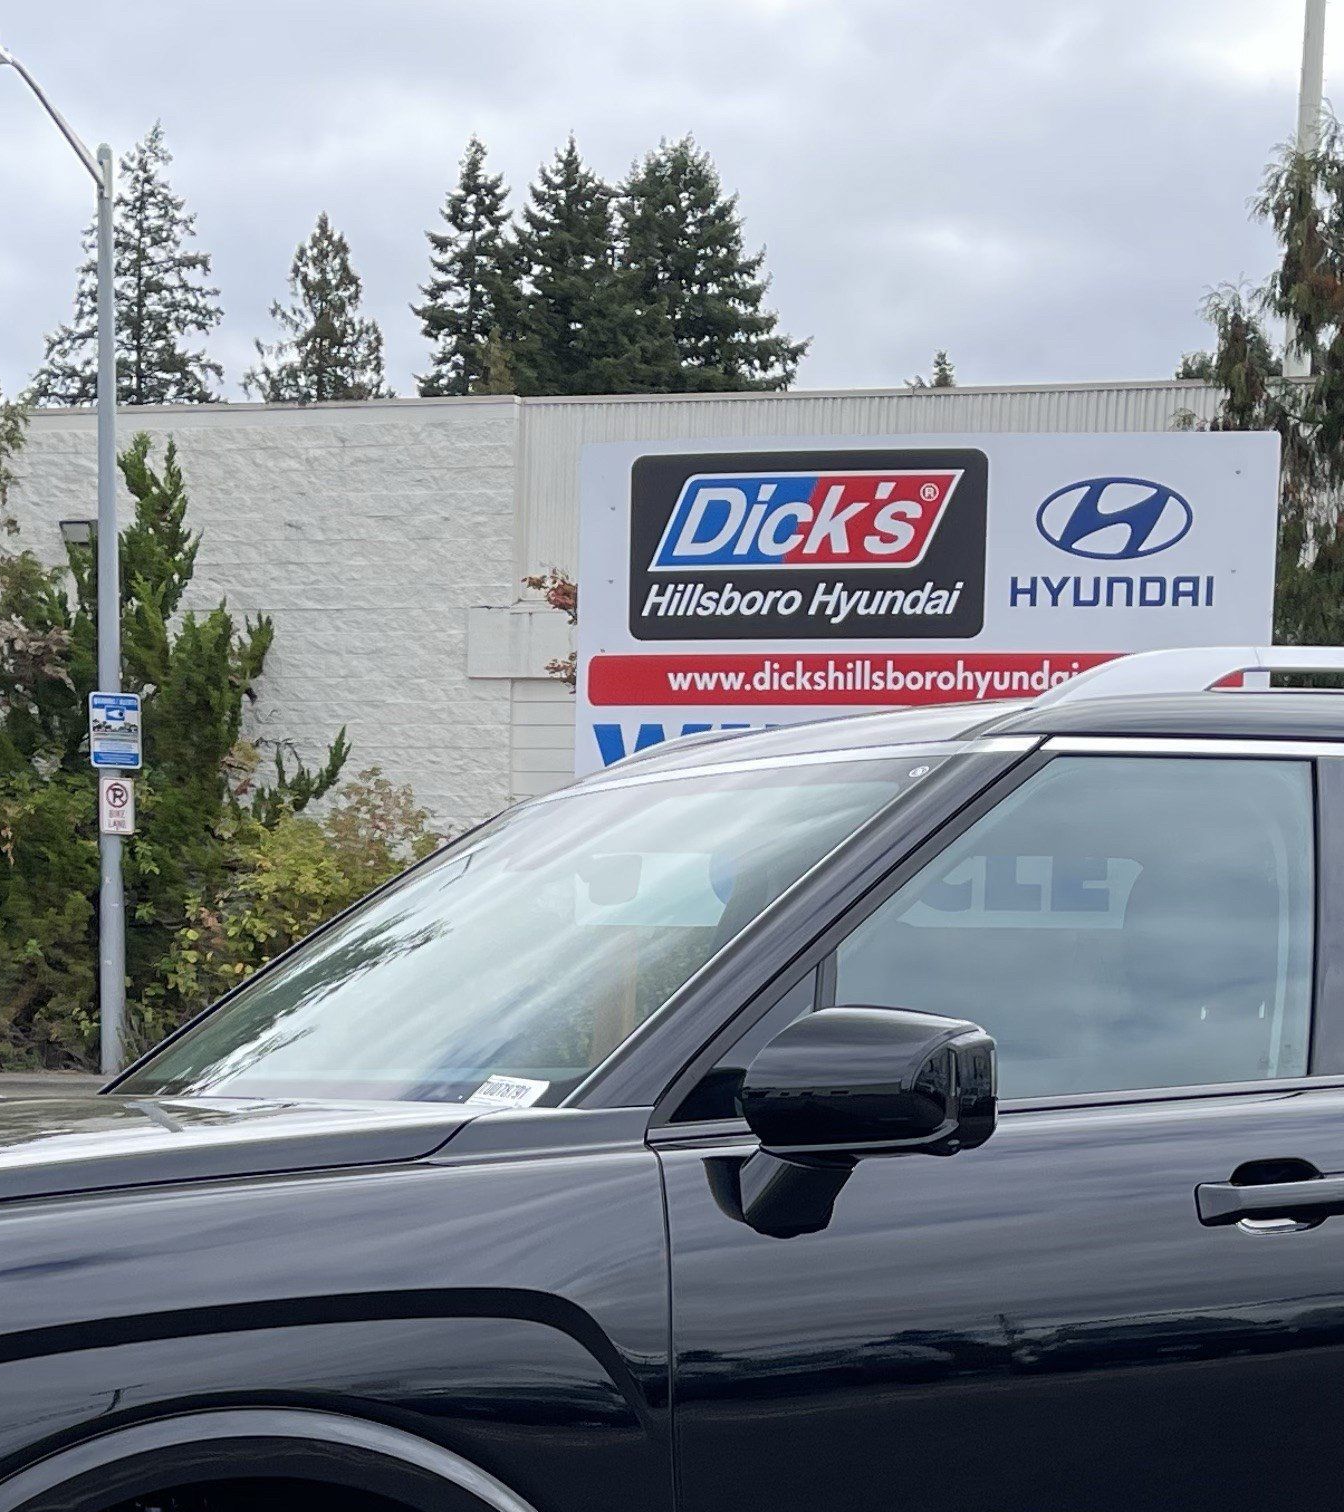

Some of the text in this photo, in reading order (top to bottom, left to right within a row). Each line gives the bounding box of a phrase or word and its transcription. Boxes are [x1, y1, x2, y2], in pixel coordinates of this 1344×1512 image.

[641, 581, 964, 624] Hillsboro Hyundai
[1009, 575, 1215, 608] HYUNDAI
